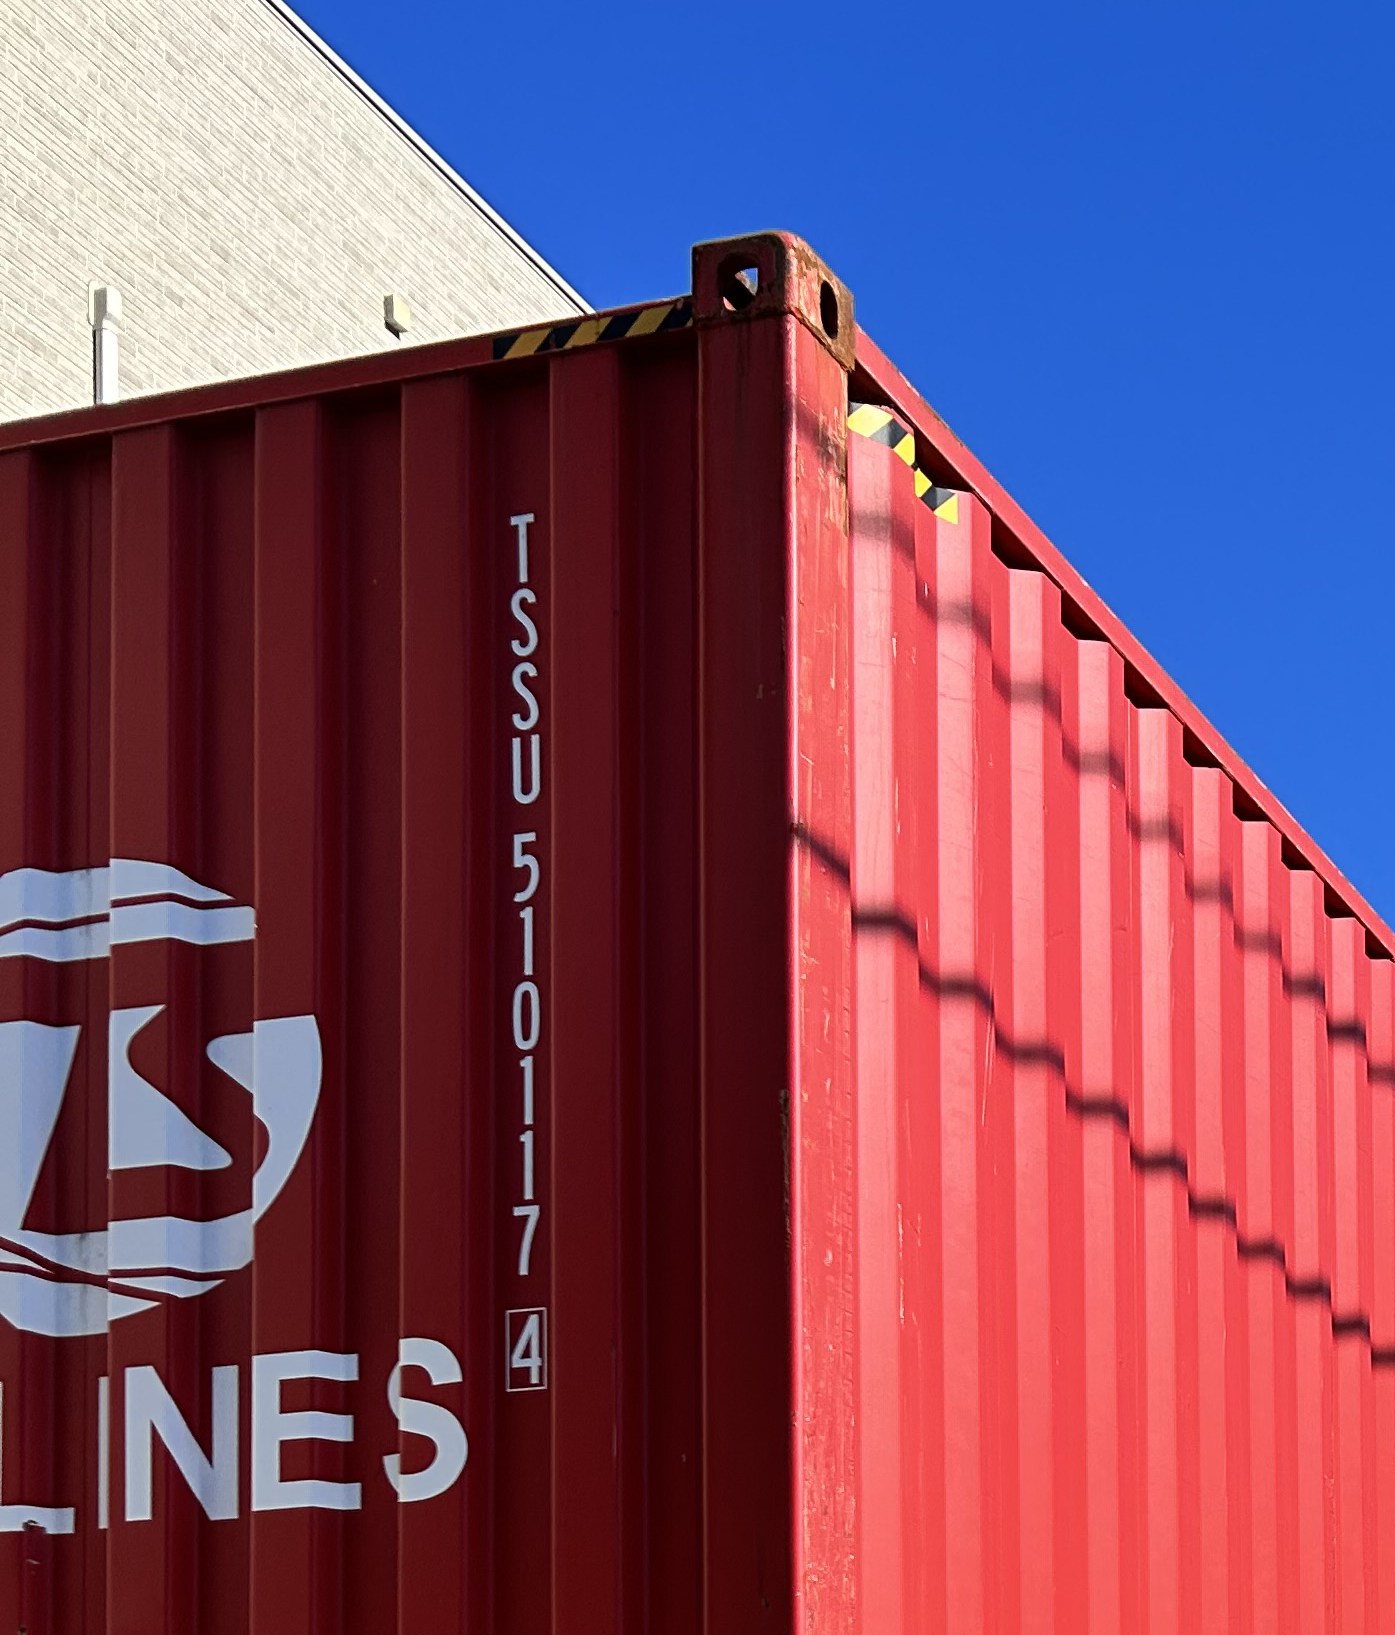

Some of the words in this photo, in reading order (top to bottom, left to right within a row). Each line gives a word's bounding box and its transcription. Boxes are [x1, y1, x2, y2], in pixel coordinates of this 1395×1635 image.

[510, 512, 542, 804] TSSU
[511, 831, 542, 1276] 510117
[511, 1314, 542, 1385] 4
